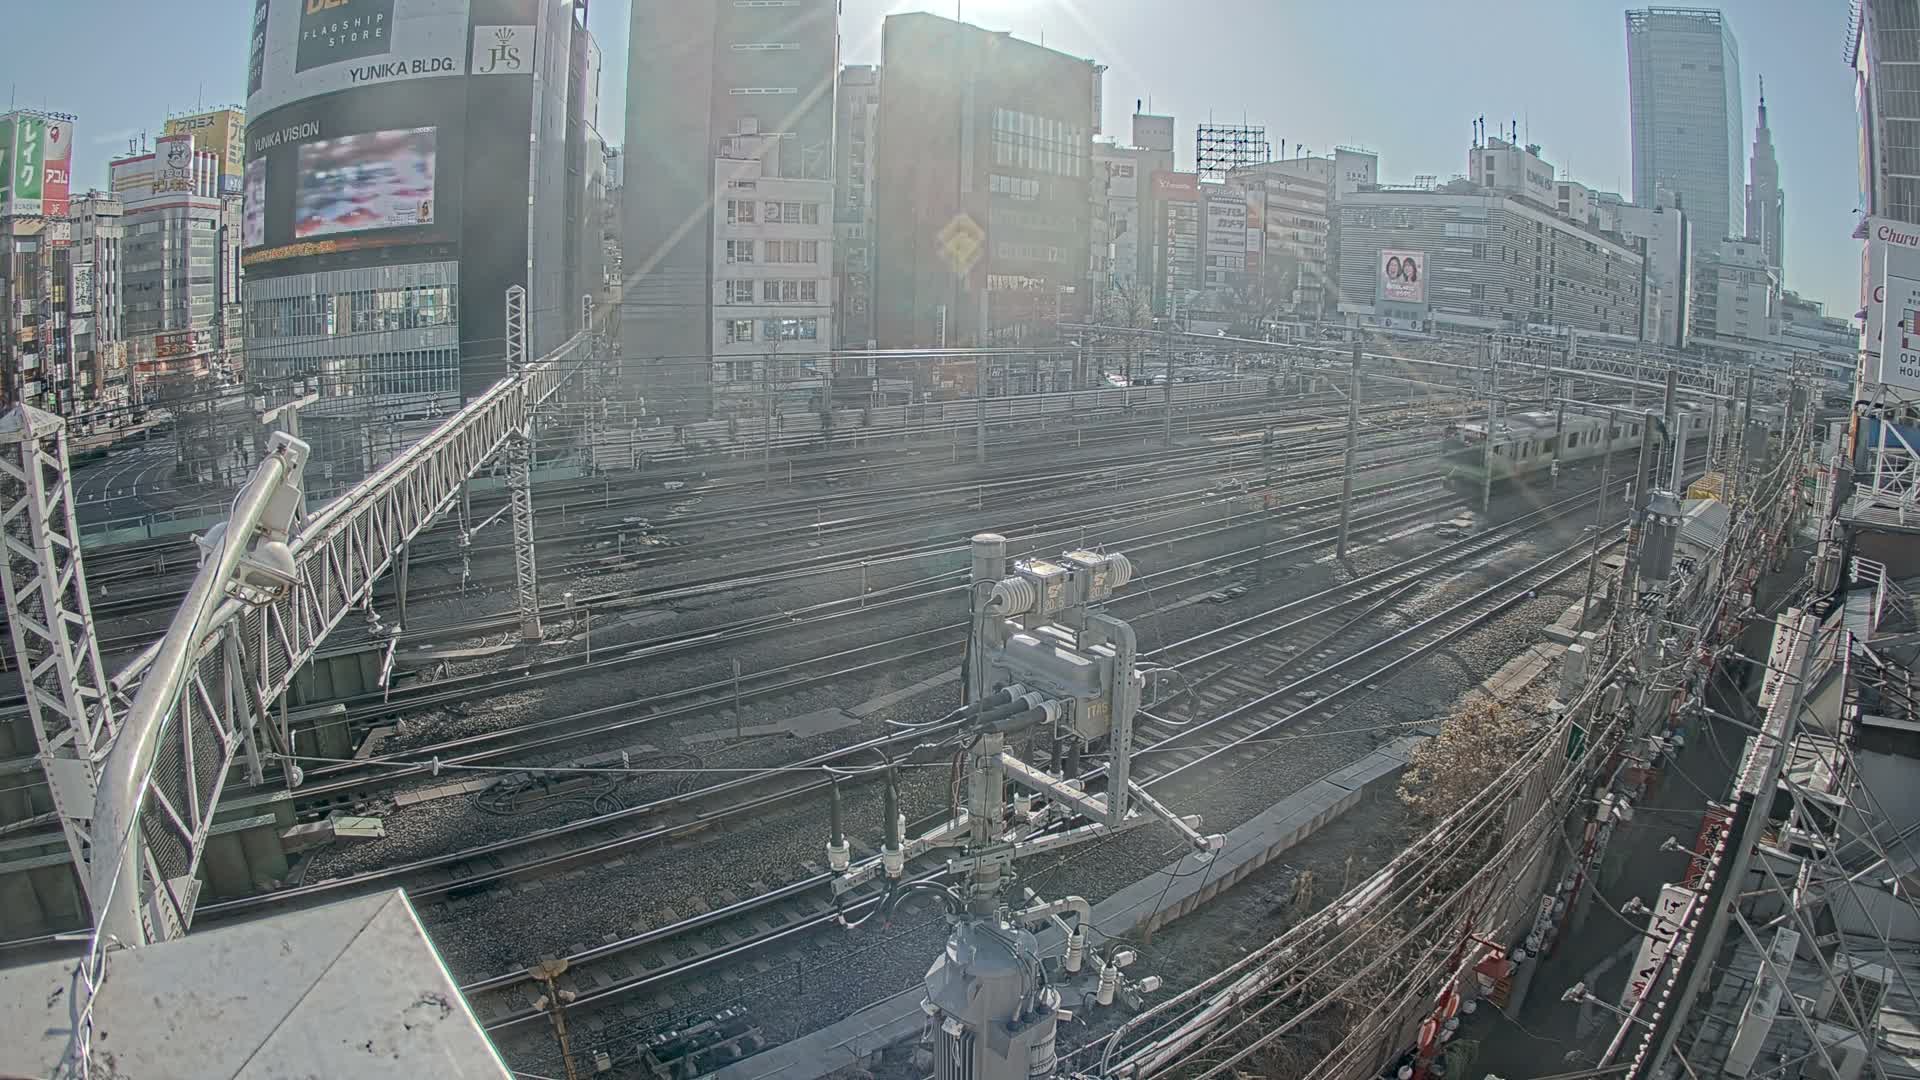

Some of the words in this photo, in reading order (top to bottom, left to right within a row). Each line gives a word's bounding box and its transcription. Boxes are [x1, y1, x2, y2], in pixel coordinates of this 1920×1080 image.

[303, 13, 384, 40] FLAGSHIP
[328, 28, 382, 46] STORE
[350, 62, 408, 83] YUNIKA
[411, 57, 456, 74] BLDG.
[255, 131, 281, 152] YUNIKA
[282, 119, 320, 143] VISION
[21, 122, 37, 188] レイク
[46, 169, 69, 184] アコム
[1878, 225, 1920, 246] Churu
